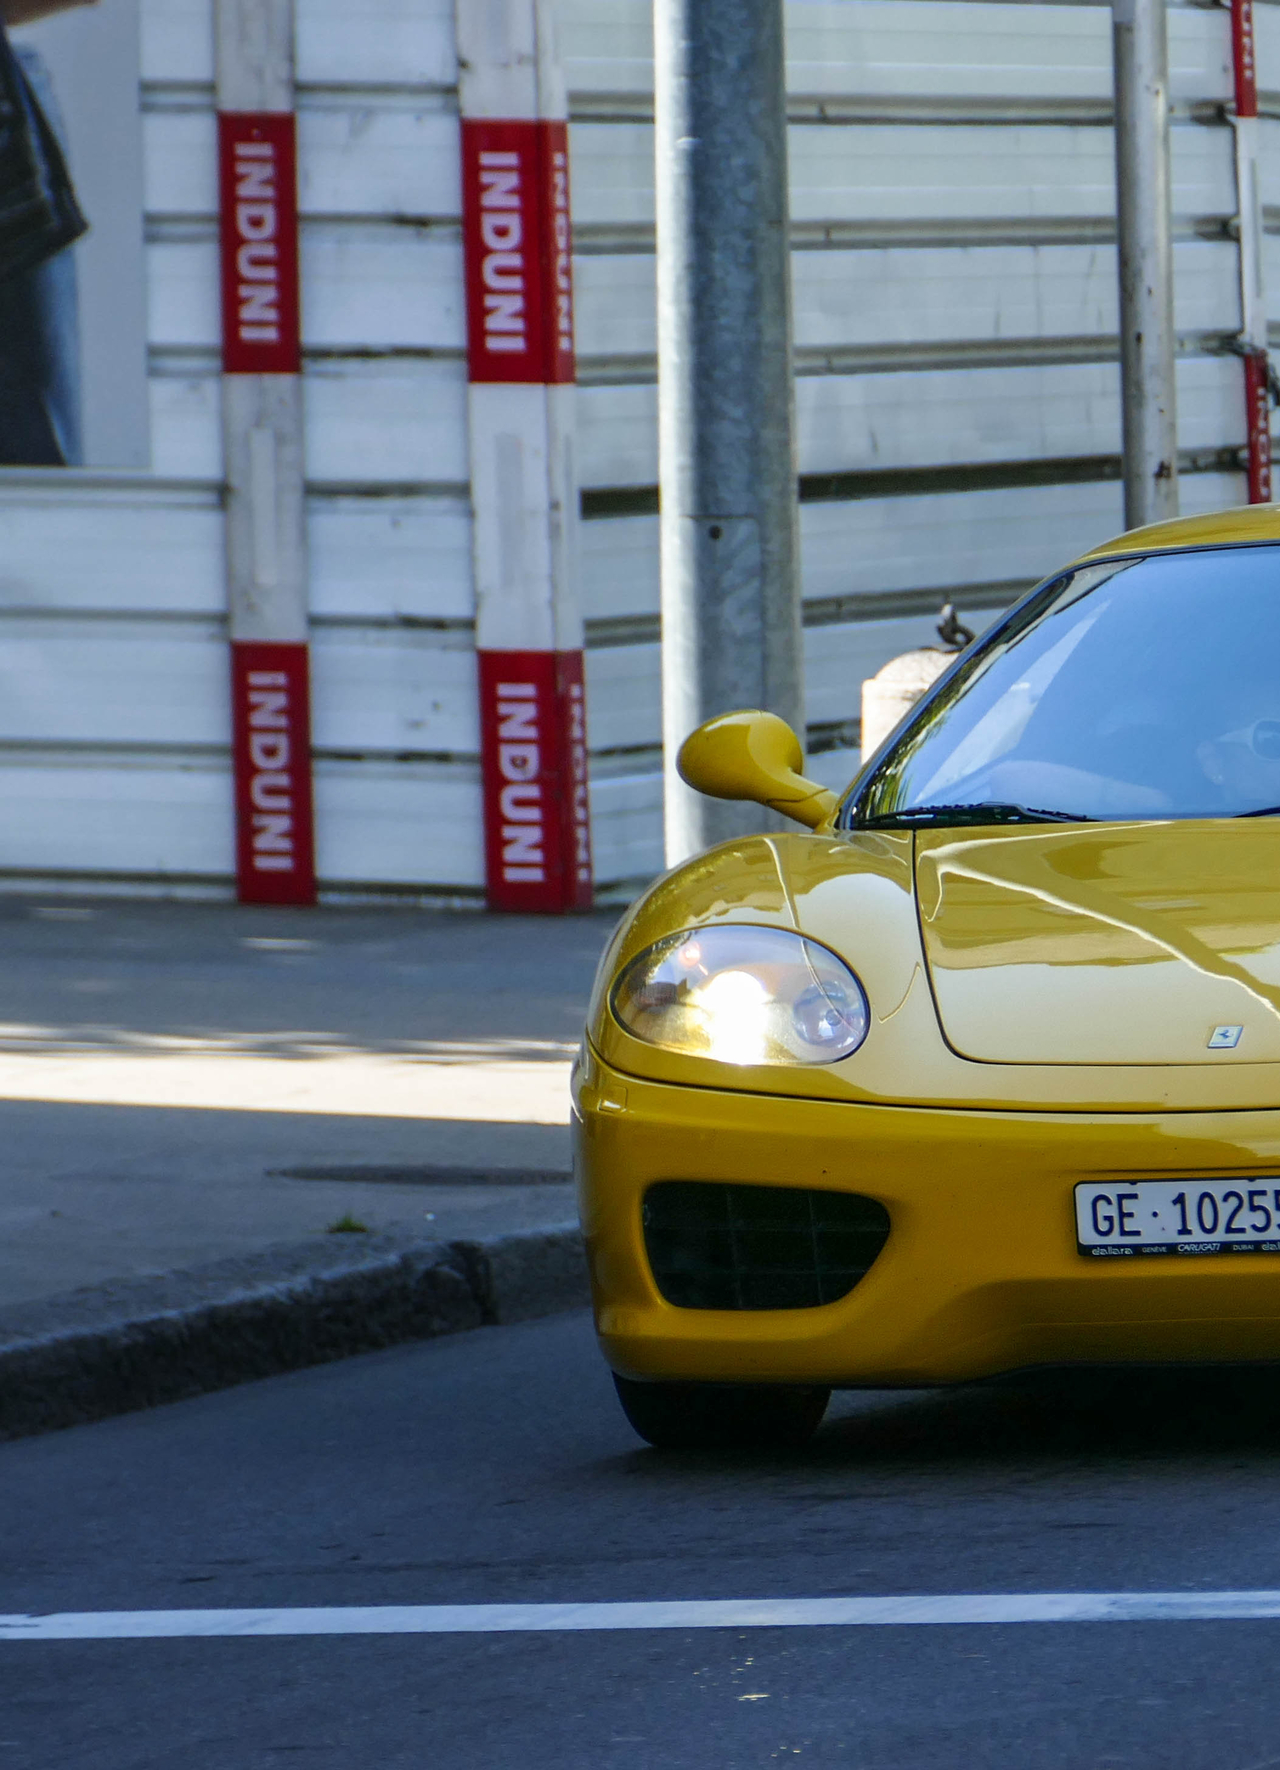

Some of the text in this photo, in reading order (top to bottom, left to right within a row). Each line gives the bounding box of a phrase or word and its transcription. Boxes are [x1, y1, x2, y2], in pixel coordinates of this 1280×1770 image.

[234, 141, 280, 344] INDUNI
[479, 151, 527, 354] INDUNI
[553, 152, 572, 351] INDUNI
[248, 669, 295, 872] INDUNI
[496, 682, 546, 883] INDUNI
[570, 683, 591, 881] INDUNI
[1177, 1242, 1221, 1251] CARUGATI
